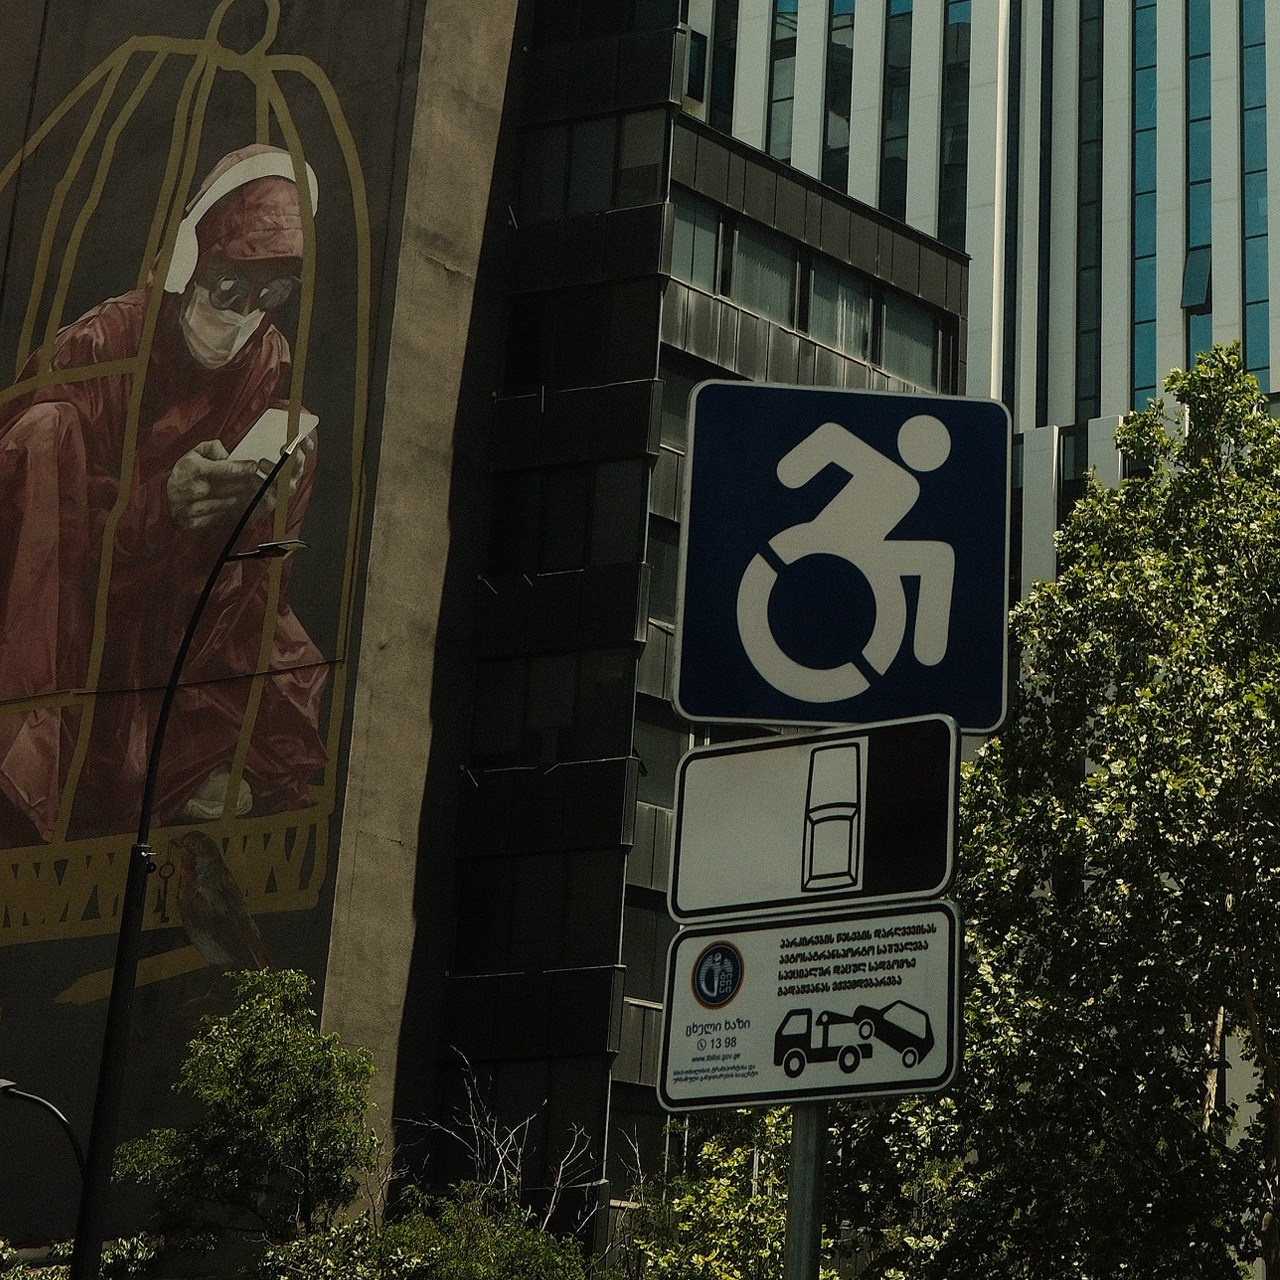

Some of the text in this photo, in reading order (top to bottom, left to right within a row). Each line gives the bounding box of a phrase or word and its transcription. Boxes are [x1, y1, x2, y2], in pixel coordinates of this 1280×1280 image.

[686, 1018, 750, 1037] ცხელი ხაზი
[711, 1036, 737, 1049] 13 98
